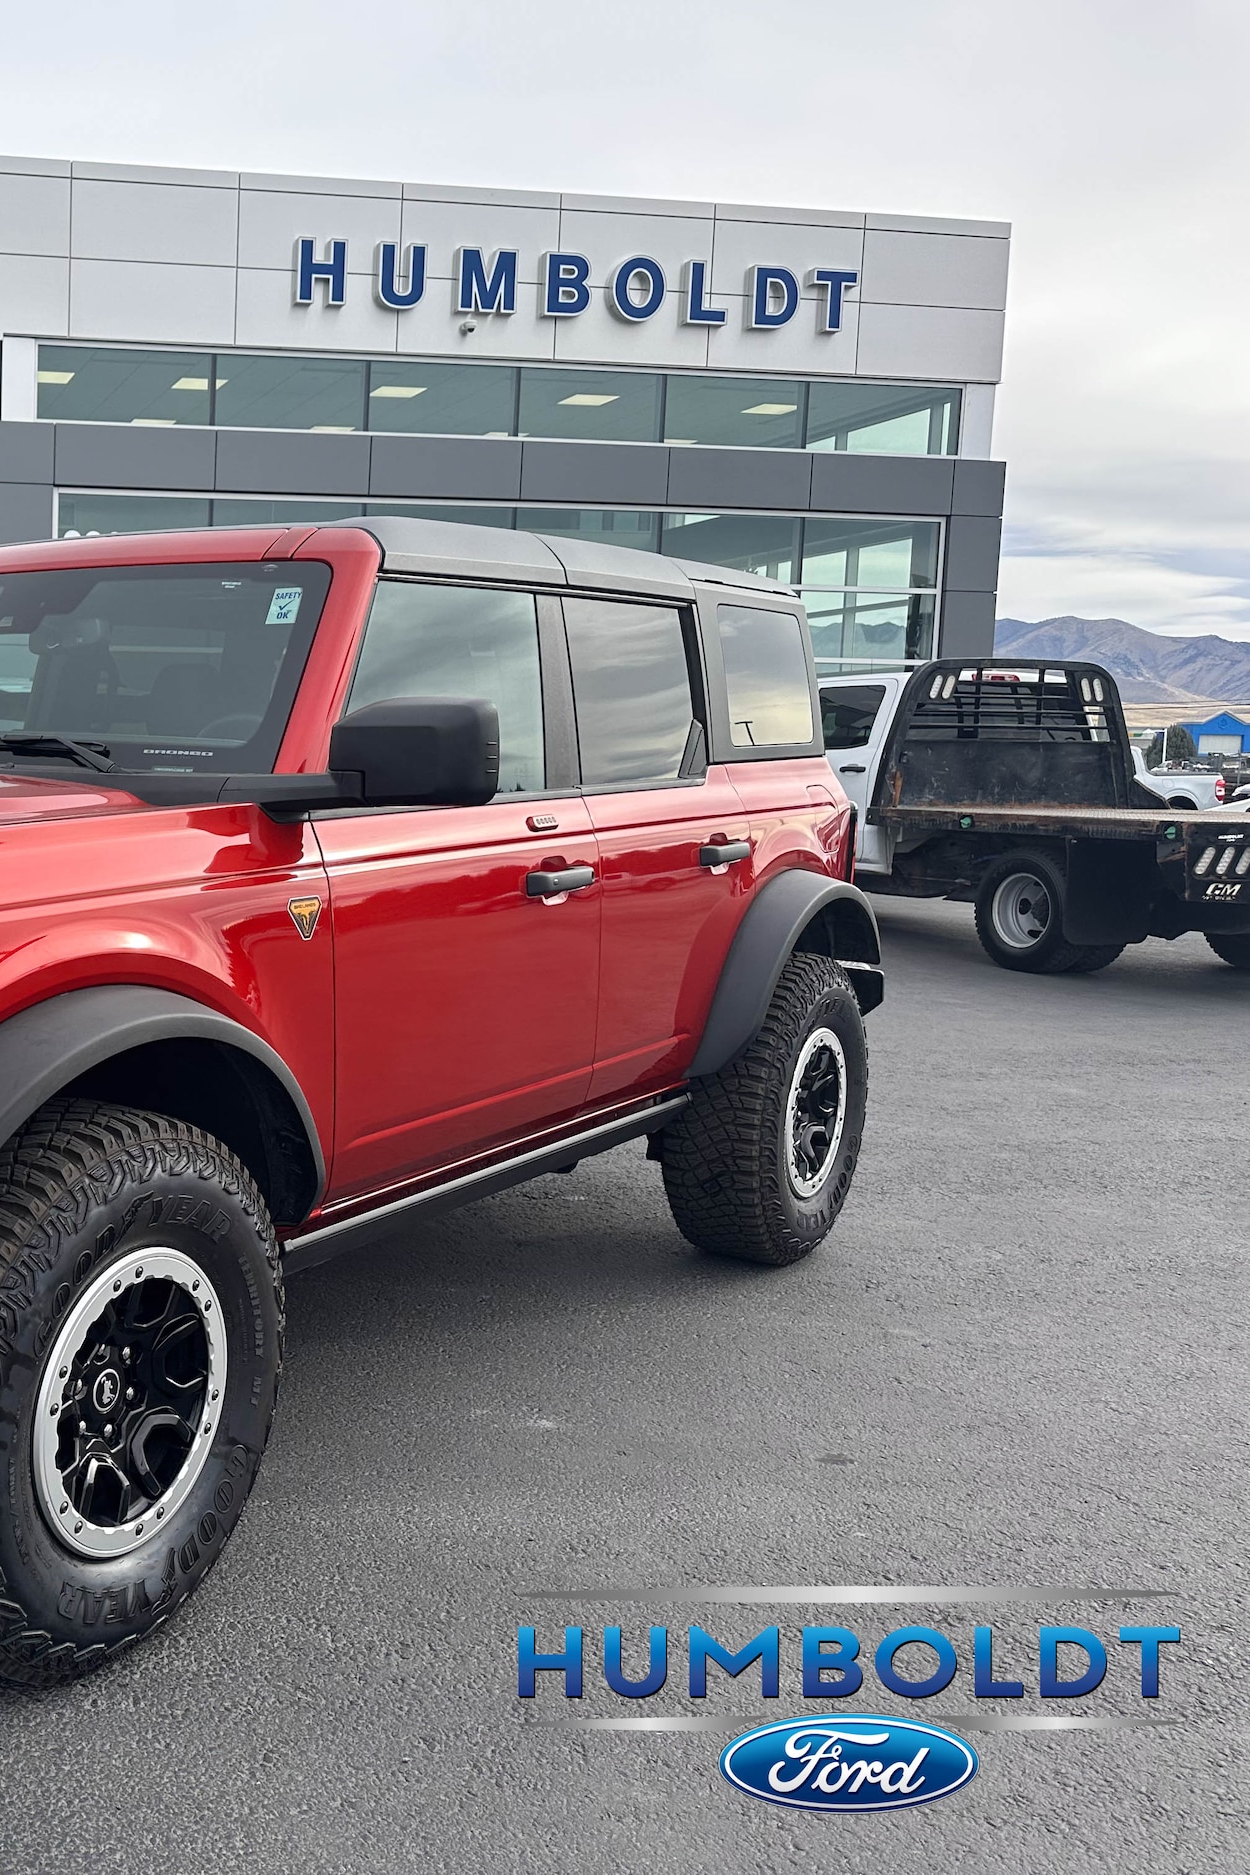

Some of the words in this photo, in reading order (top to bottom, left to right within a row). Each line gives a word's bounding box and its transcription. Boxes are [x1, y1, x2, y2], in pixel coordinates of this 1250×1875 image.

[295, 236, 860, 332] HUMBOLDT
[275, 591, 302, 600] SAFETY
[276, 610, 291, 620] OK
[237, 1254, 265, 1357] TERRITORY
